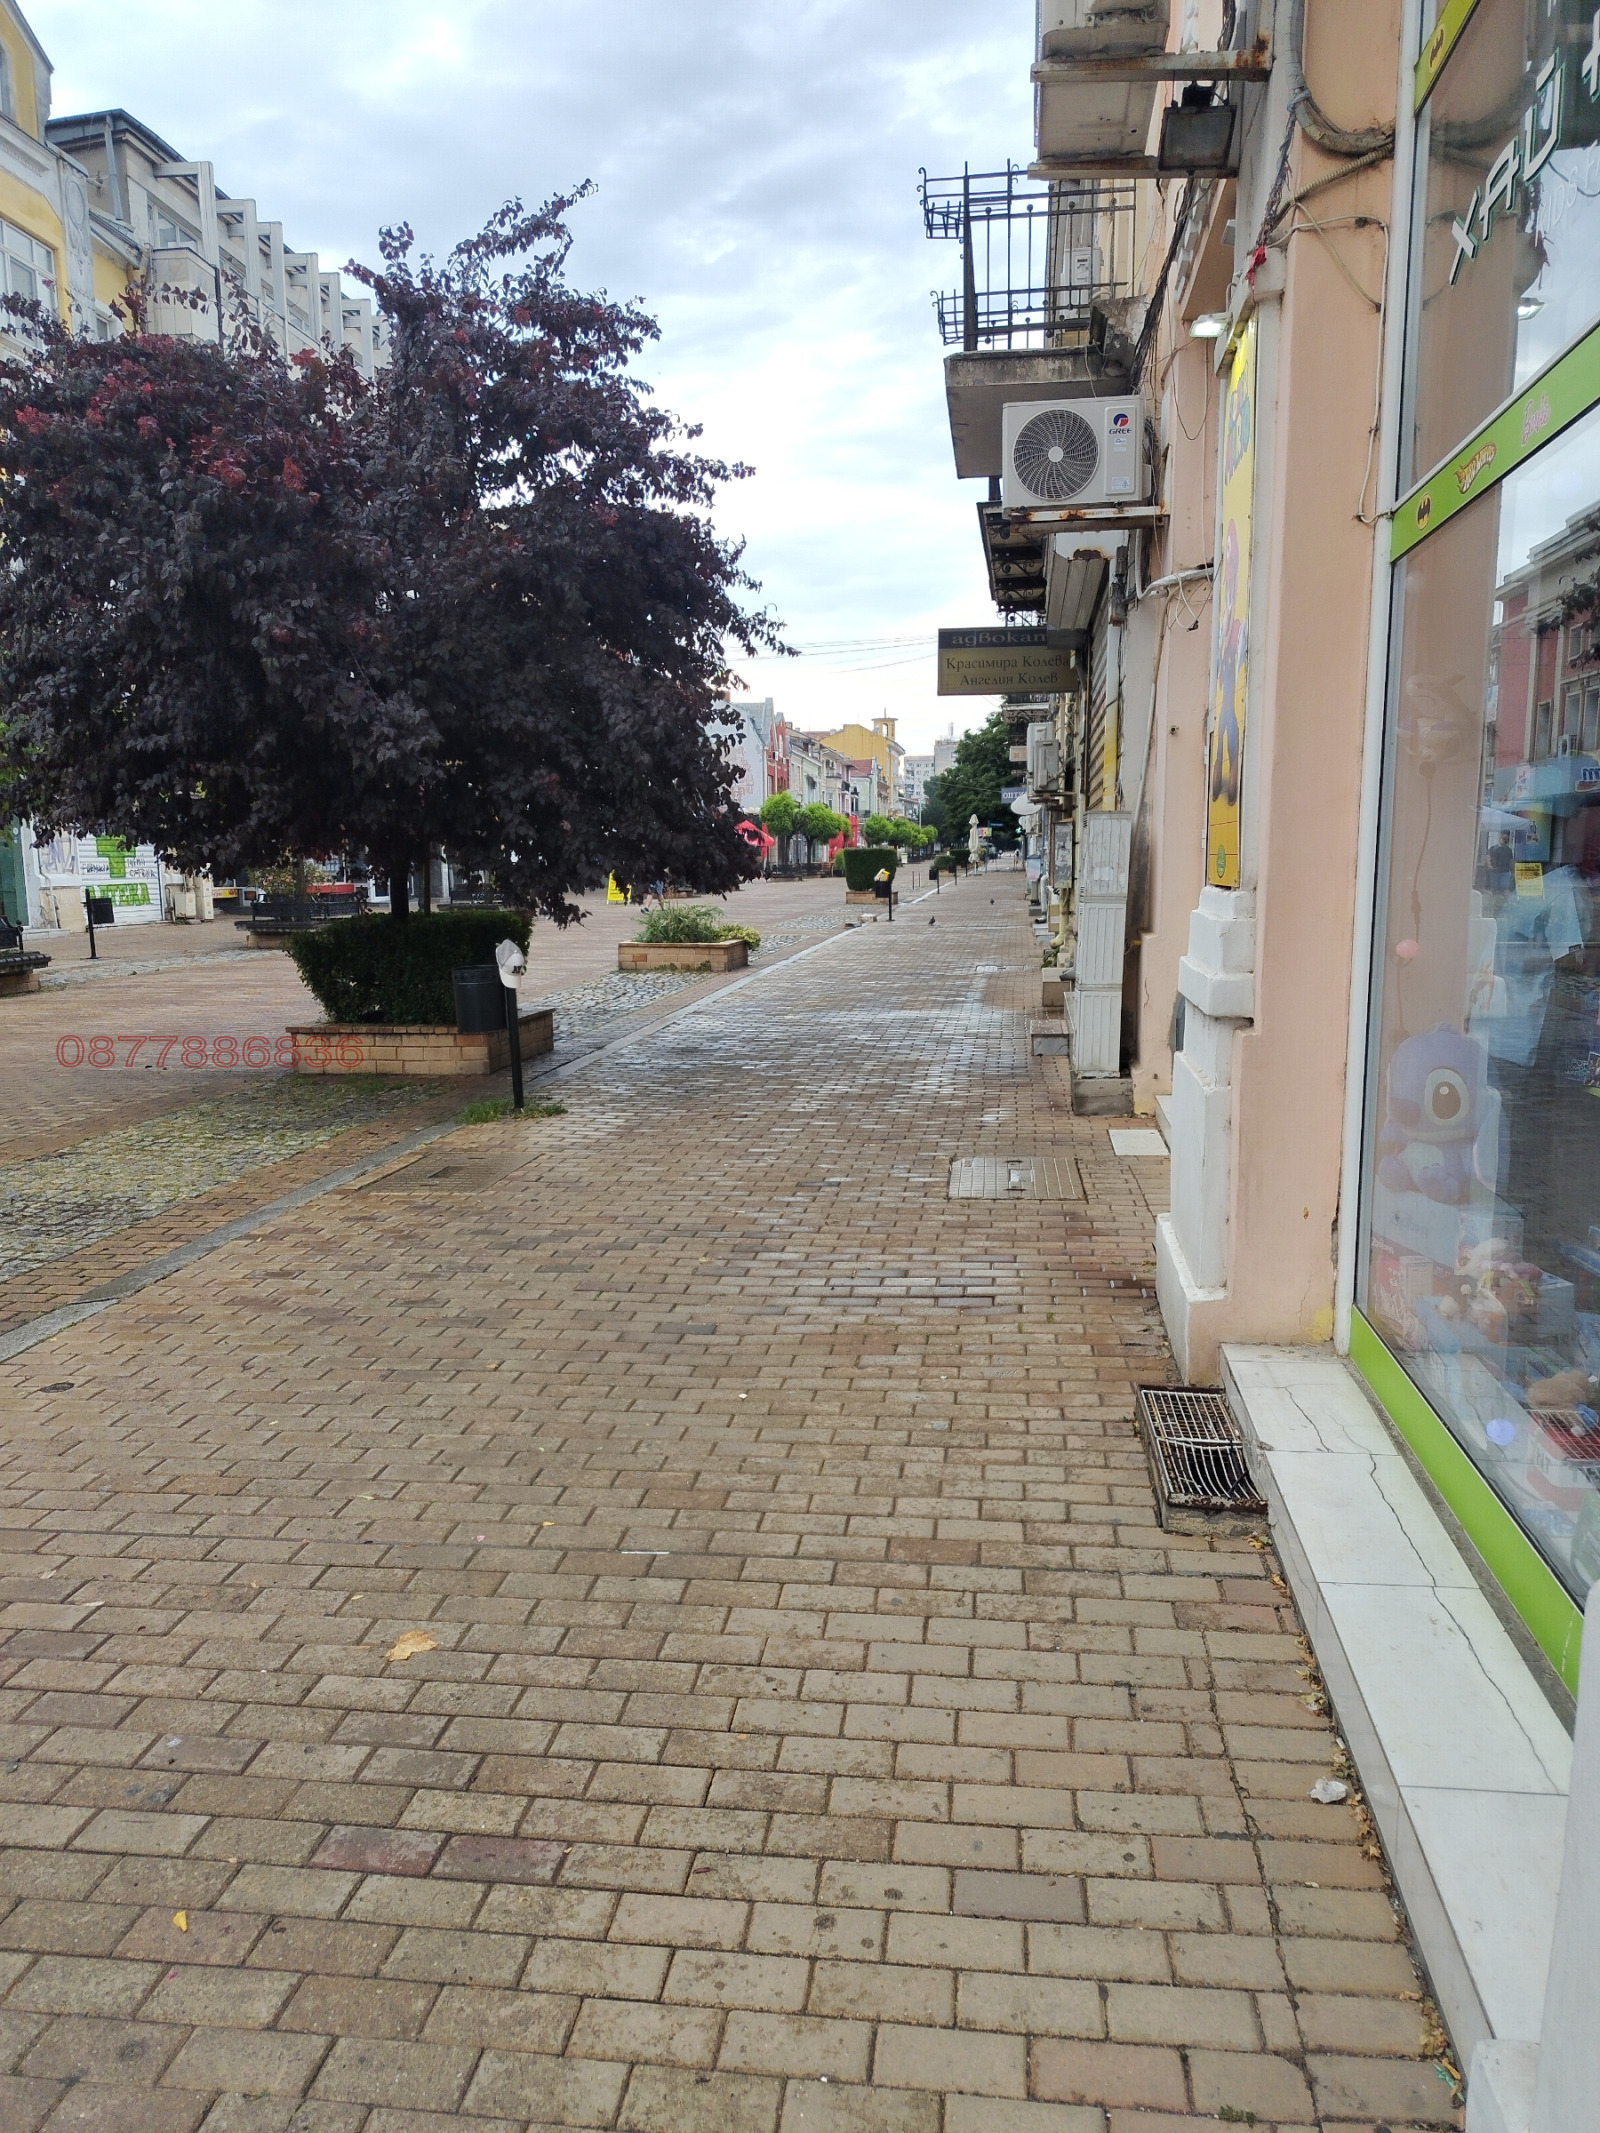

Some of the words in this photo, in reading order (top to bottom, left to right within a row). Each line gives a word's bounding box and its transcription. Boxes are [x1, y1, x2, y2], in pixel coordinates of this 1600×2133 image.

[1534, 166, 1579, 249] KIDS
[1109, 427, 1132, 435] GREE
[946, 657, 1018, 672] Красимира
[1022, 654, 1070, 668] Колева
[960, 675, 1014, 687] Ангелин
[1018, 672, 1059, 685] Колев
